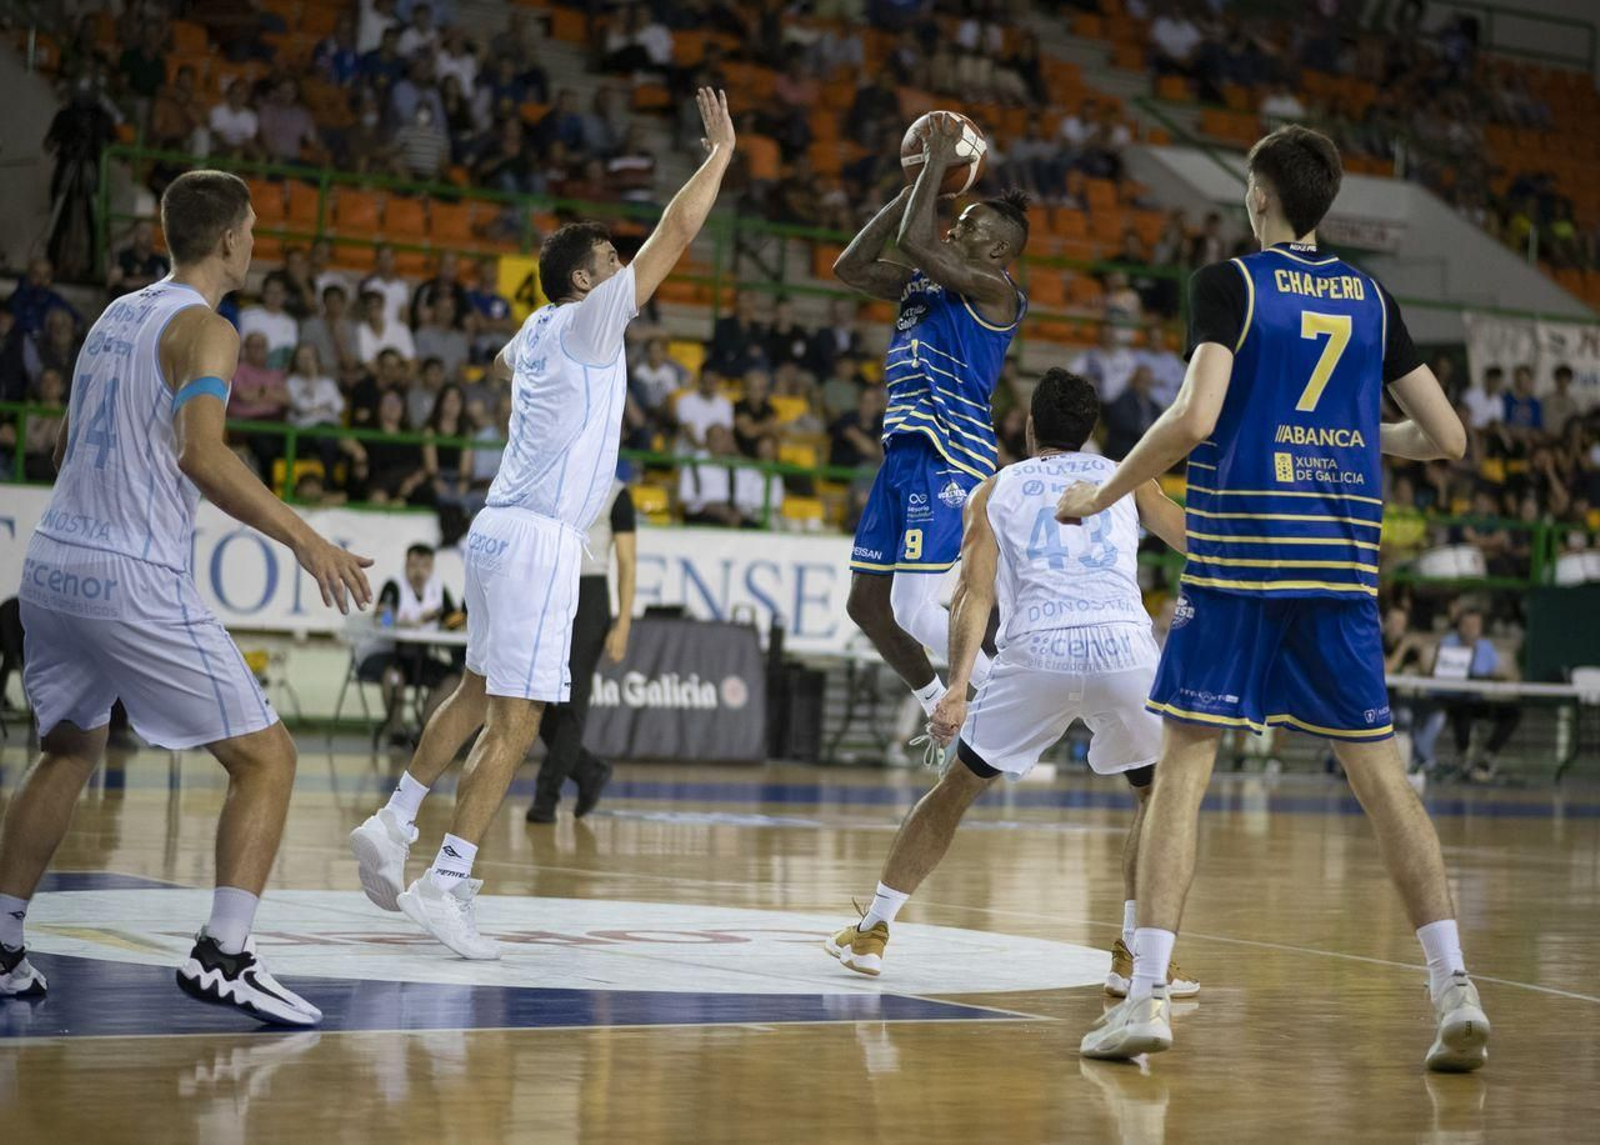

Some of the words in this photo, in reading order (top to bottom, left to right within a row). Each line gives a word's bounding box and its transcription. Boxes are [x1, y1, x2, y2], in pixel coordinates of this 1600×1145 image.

[1274, 269, 1365, 301] CHAPERO
[1295, 310, 1353, 413] 7
[1281, 425, 1366, 448] ABANCA
[1295, 456, 1339, 470] XUNTA
[1296, 469, 1314, 482] DE
[1315, 470, 1366, 486] GALICIA
[904, 529, 924, 560] 9
[1029, 505, 1119, 570] 43
[33, 563, 118, 601] cenor
[621, 670, 718, 709] Galicia
